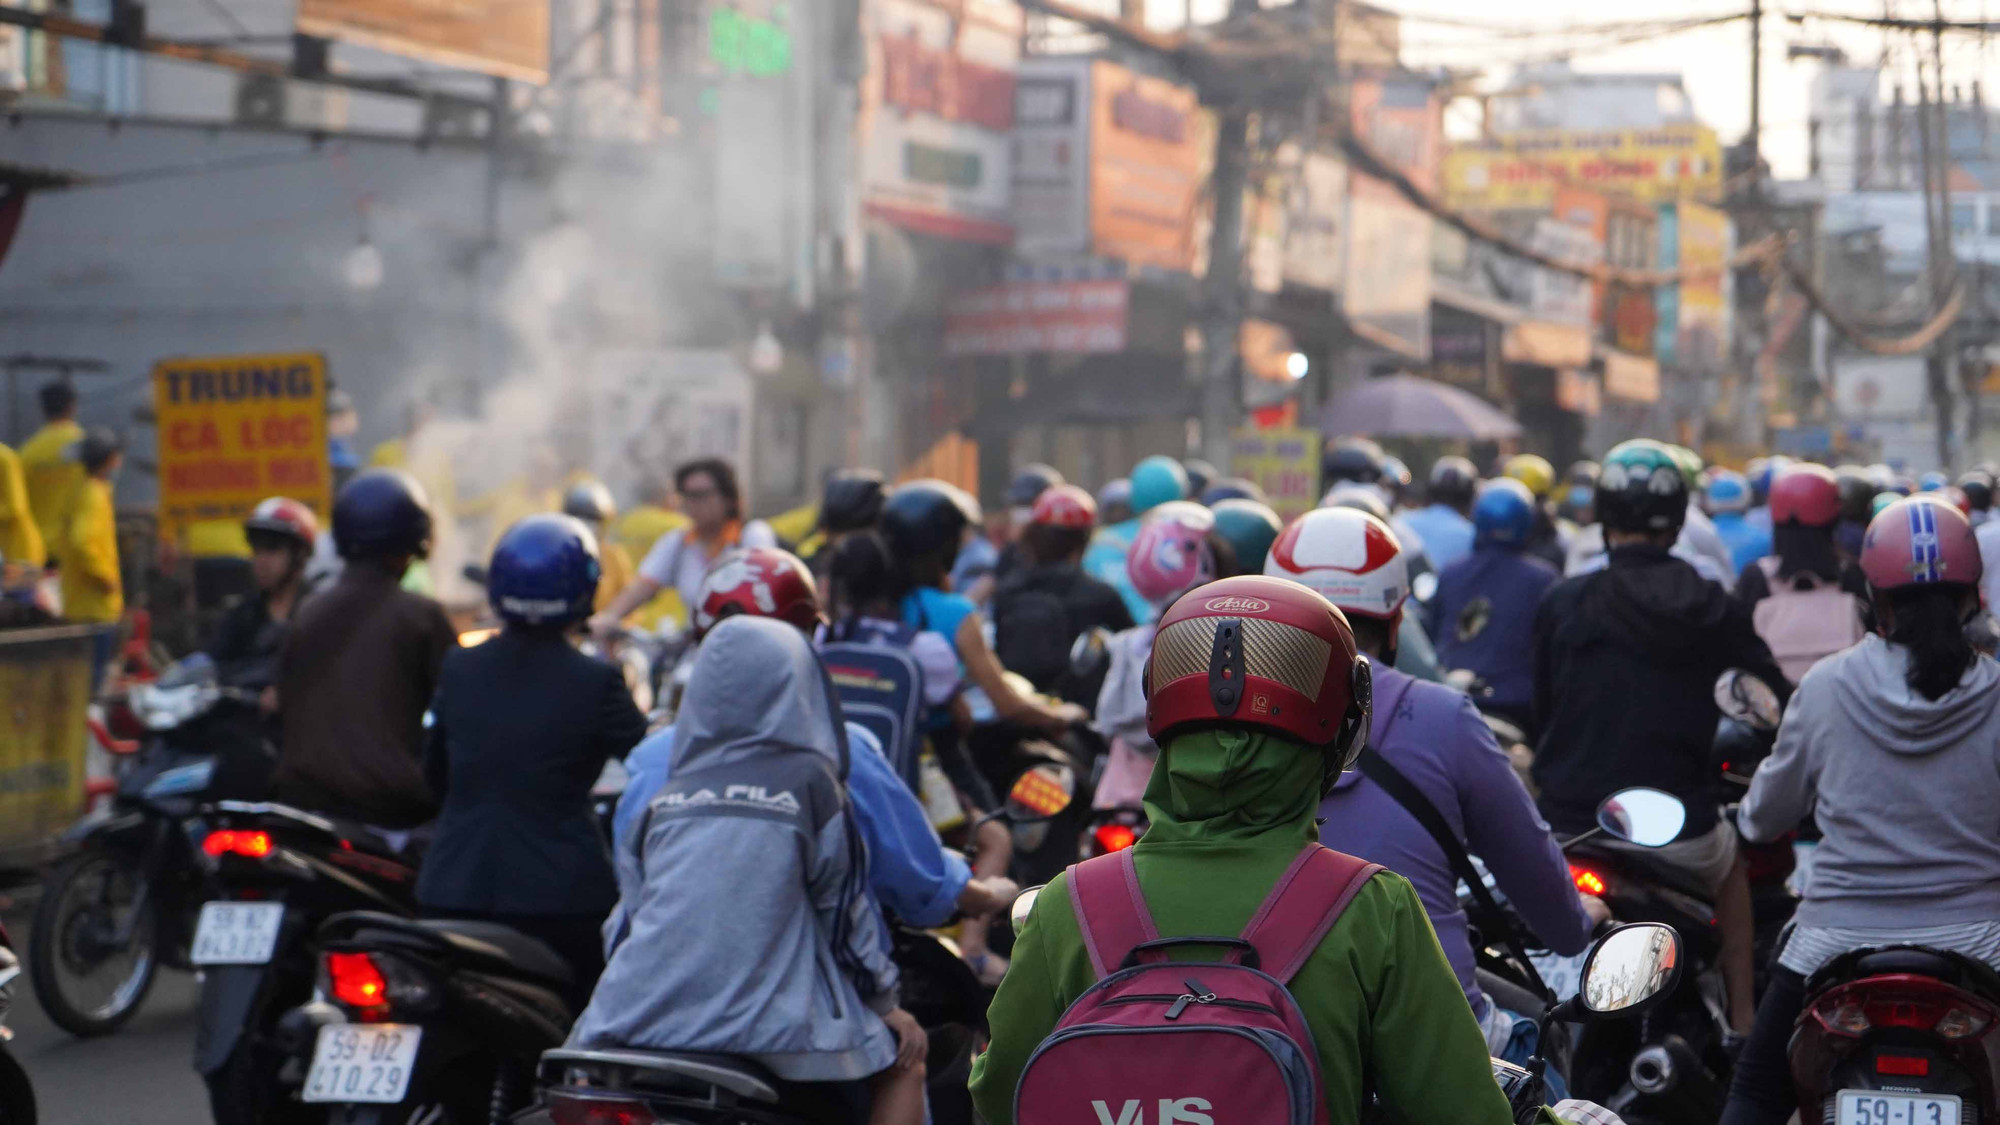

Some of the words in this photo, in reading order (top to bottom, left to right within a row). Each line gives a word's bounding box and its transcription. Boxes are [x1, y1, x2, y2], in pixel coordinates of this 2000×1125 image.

[168, 366, 312, 404] TRUNG
[1213, 597, 1260, 609] Asia
[724, 784, 800, 810] FILA
